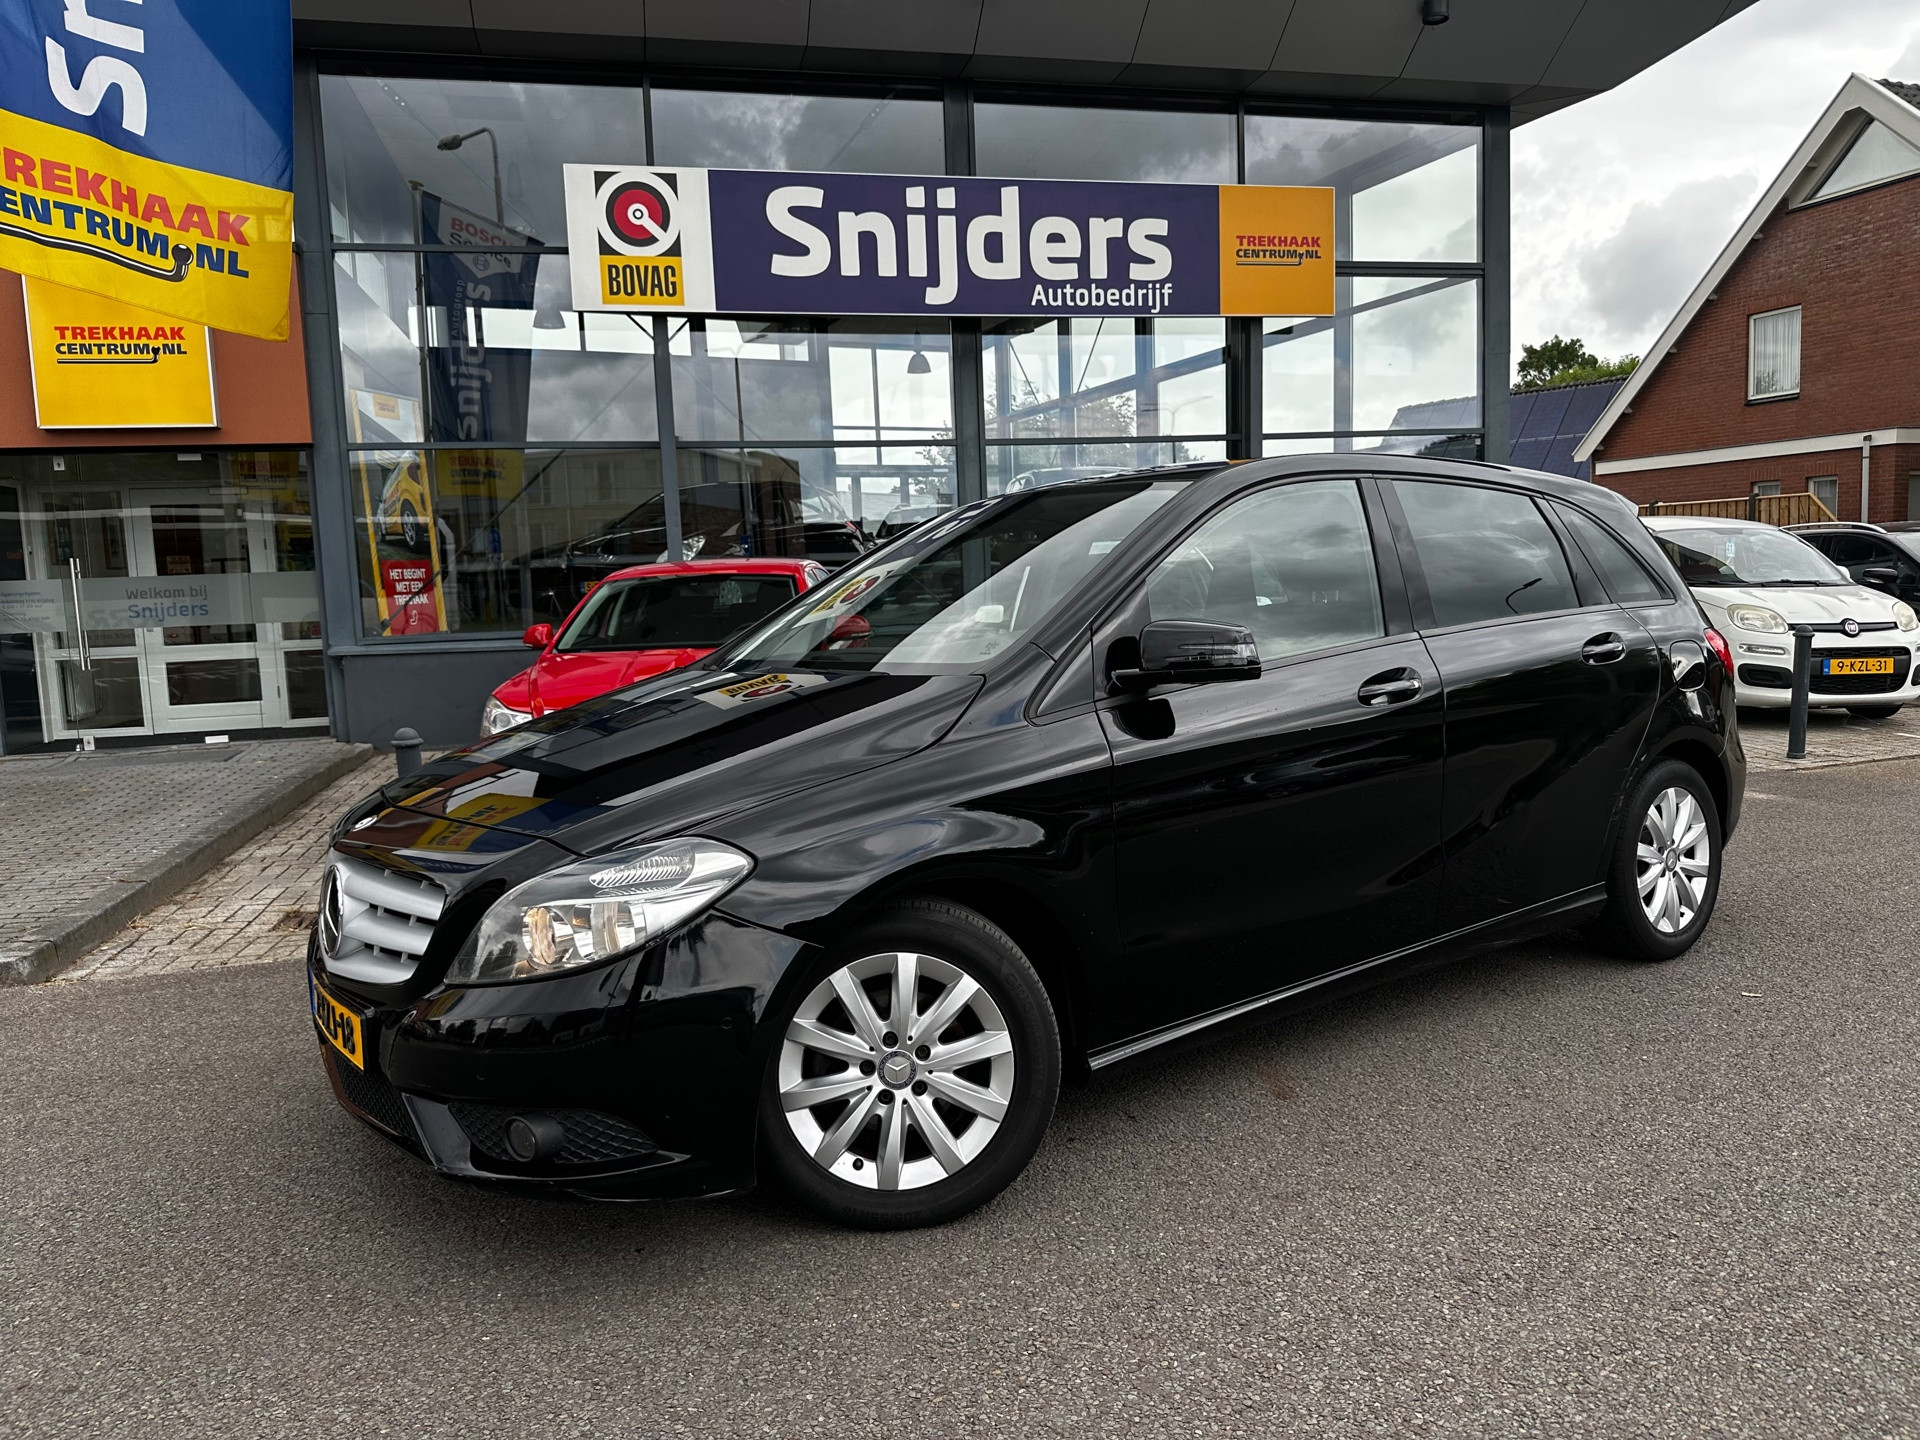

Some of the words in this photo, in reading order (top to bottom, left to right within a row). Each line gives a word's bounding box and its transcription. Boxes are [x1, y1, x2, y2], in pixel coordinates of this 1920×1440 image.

[0, 145, 250, 247] REKHAAK
[766, 185, 1173, 306] Snijders
[1236, 235, 1321, 247] TREKHAAK
[607, 263, 677, 297] BOVAG
[1031, 283, 1173, 313] Autobedrijf
[54, 326, 186, 340] TREKHAAK
[389, 568, 402, 579] HET
[403, 568, 426, 579] BEGINT
[125, 587, 185, 600] Welkom
[190, 585, 208, 600] bij
[396, 582, 409, 592] MET
[128, 601, 209, 622] Snijders
[1837, 660, 1887, 672] 9-KZL-31
